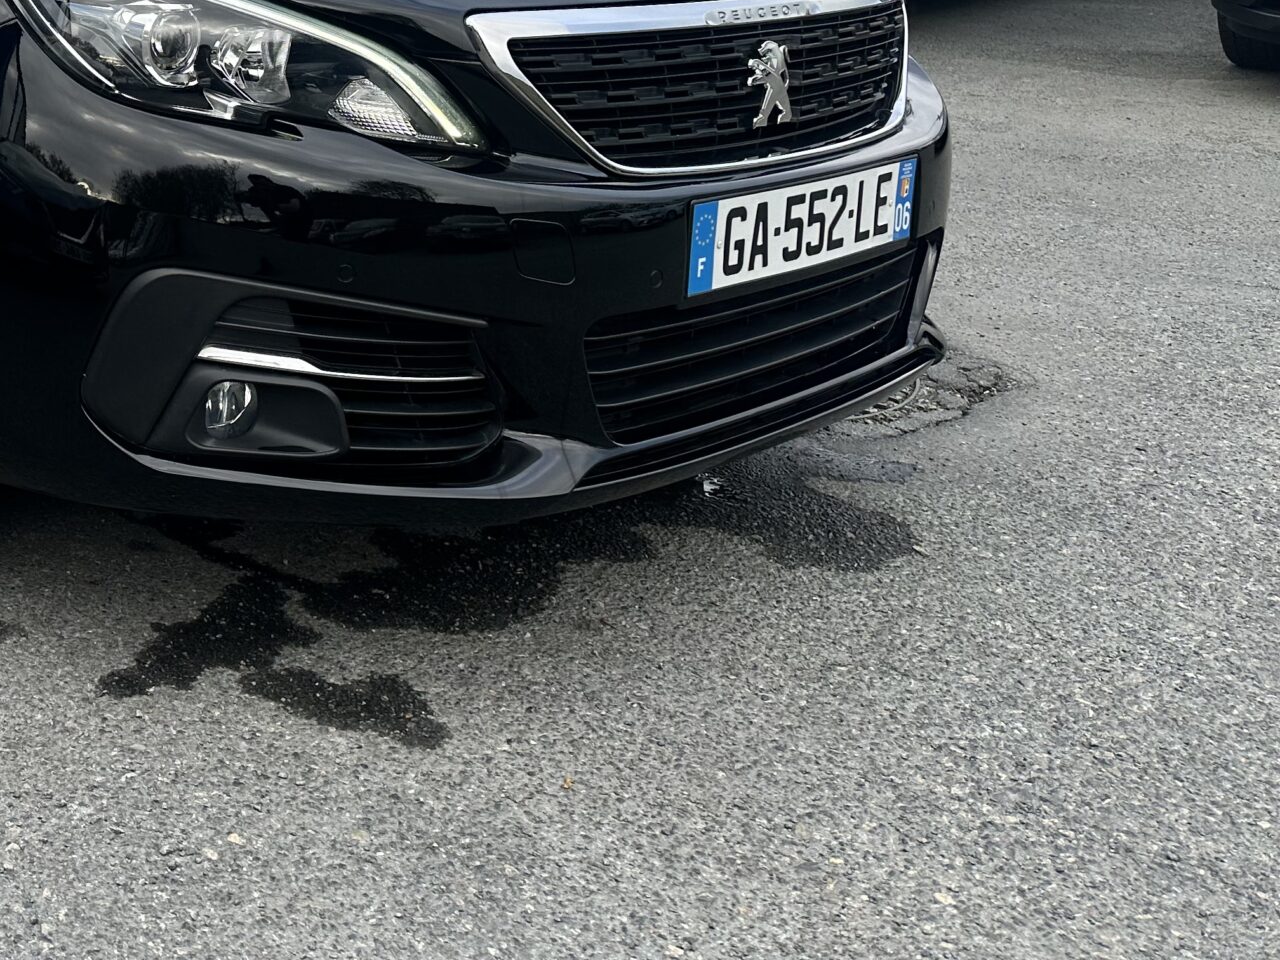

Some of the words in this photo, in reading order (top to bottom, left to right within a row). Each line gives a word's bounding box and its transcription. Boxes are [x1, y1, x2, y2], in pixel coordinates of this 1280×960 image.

[717, 3, 801, 23] PEUGEOT
[722, 171, 893, 277] GA-552-LE
[893, 202, 911, 233] 06
[696, 257, 707, 279] F
